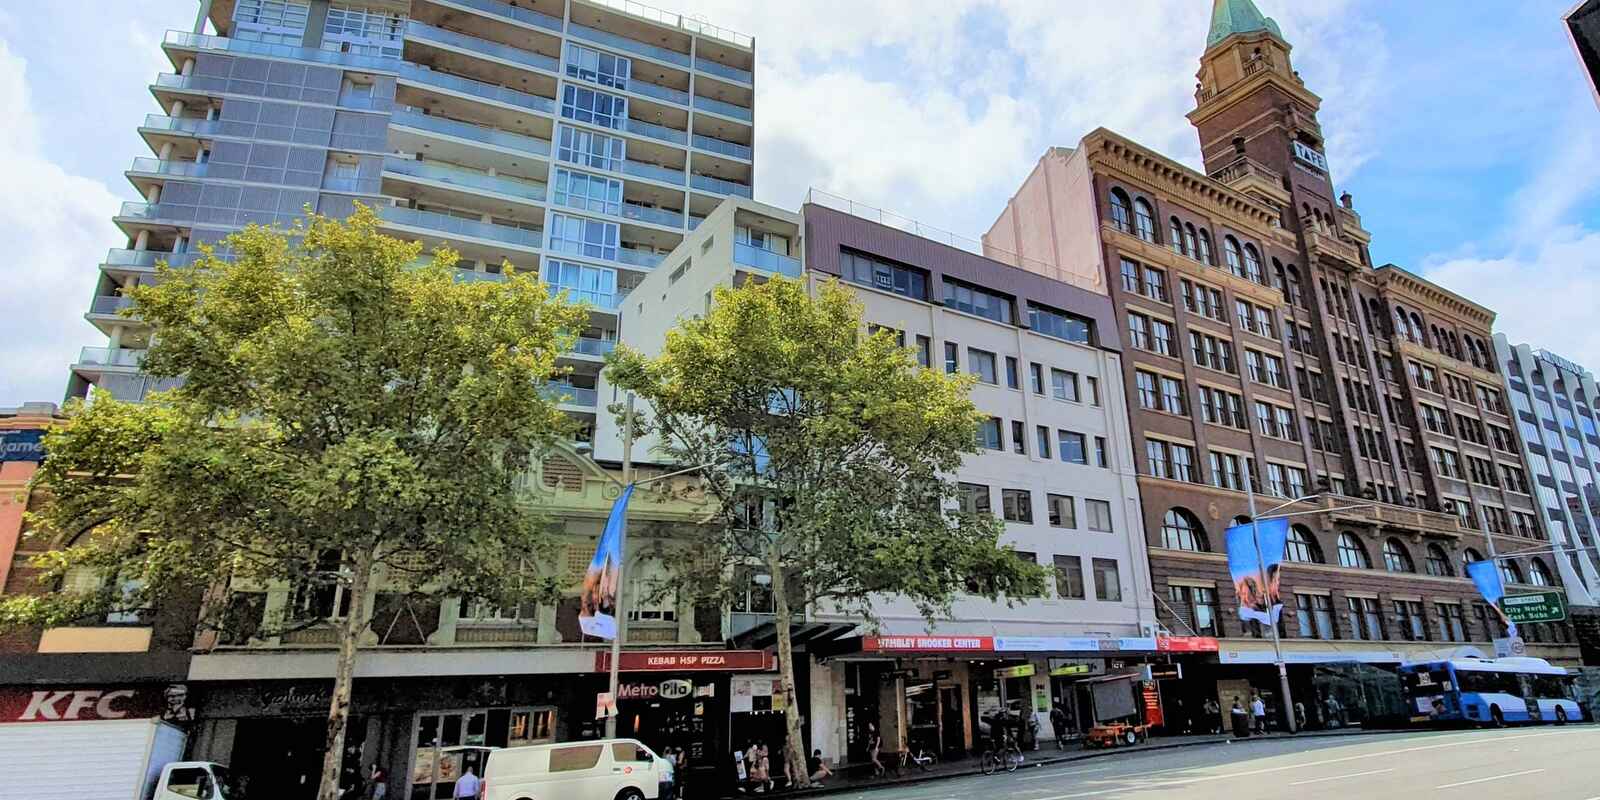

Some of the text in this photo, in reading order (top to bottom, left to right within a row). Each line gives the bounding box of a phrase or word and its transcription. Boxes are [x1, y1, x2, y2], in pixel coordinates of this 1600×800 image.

[1296, 143, 1325, 168] TAFE
[1524, 604, 1547, 612] North
[917, 638, 952, 649] SNOOKER
[954, 639, 981, 649] CENTER
[648, 656, 725, 665] KEBAB HSP PIZZA
[618, 684, 658, 697] Metro
[18, 690, 135, 720] KFC
